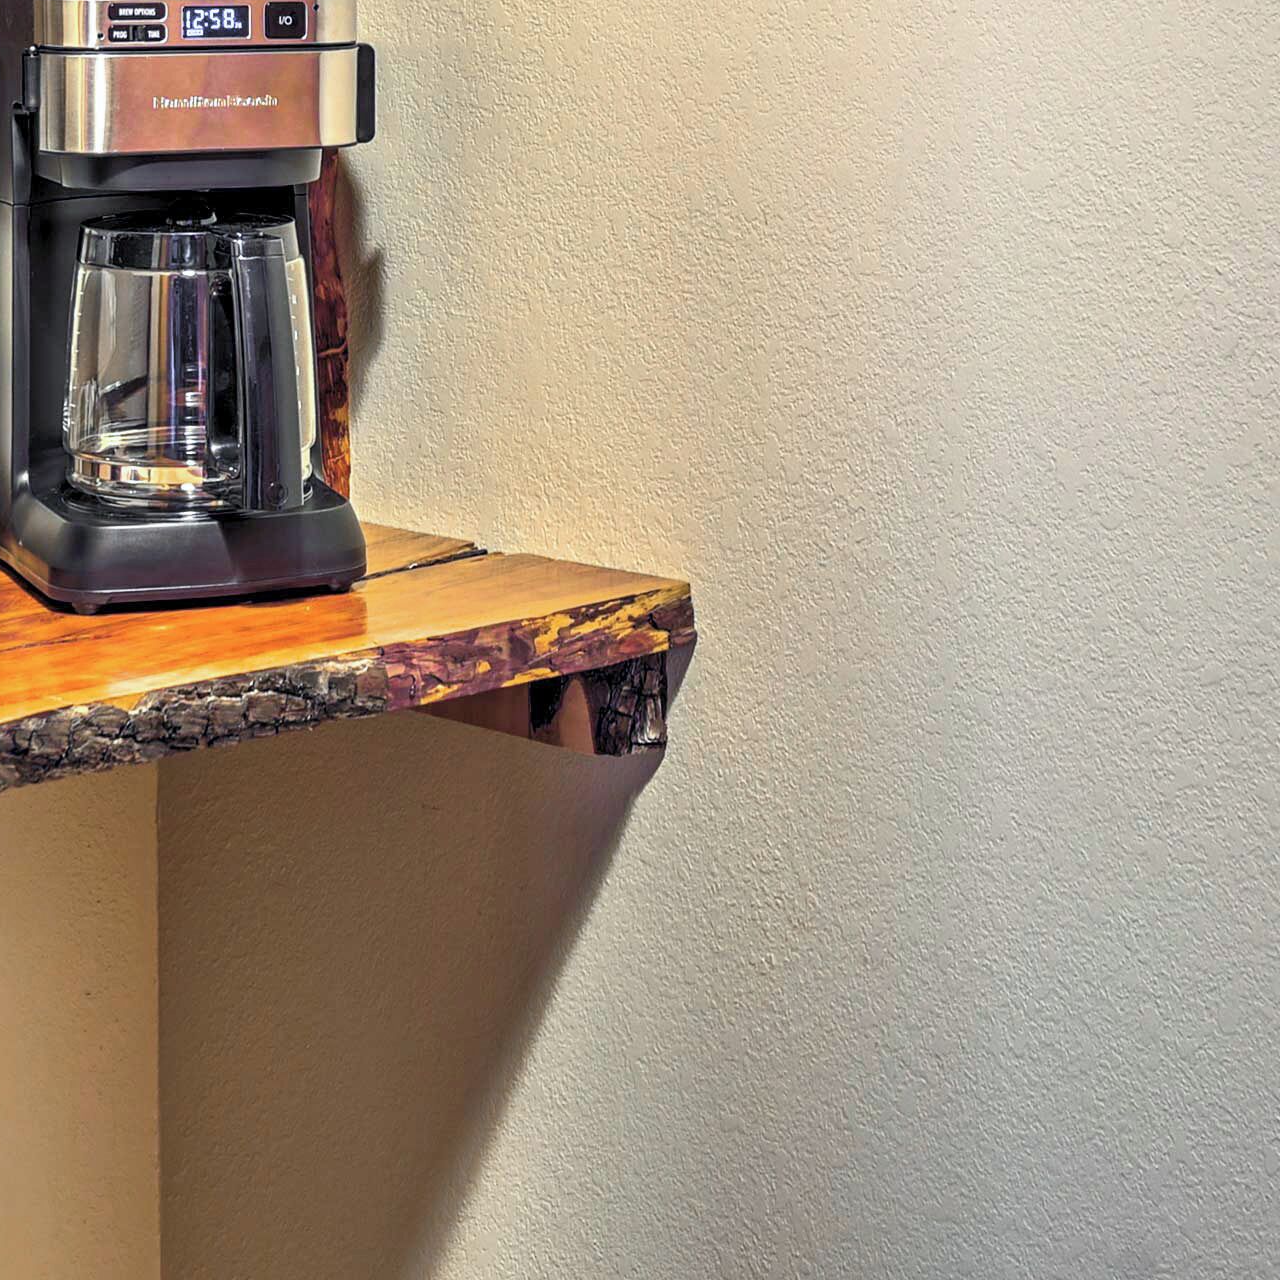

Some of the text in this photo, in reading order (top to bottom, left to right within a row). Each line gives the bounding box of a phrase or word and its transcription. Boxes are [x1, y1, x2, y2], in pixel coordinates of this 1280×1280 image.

[119, 7, 156, 16] BREW OPTIONS
[185, 8, 235, 29] 12:58
[113, 30, 128, 39] PROG
